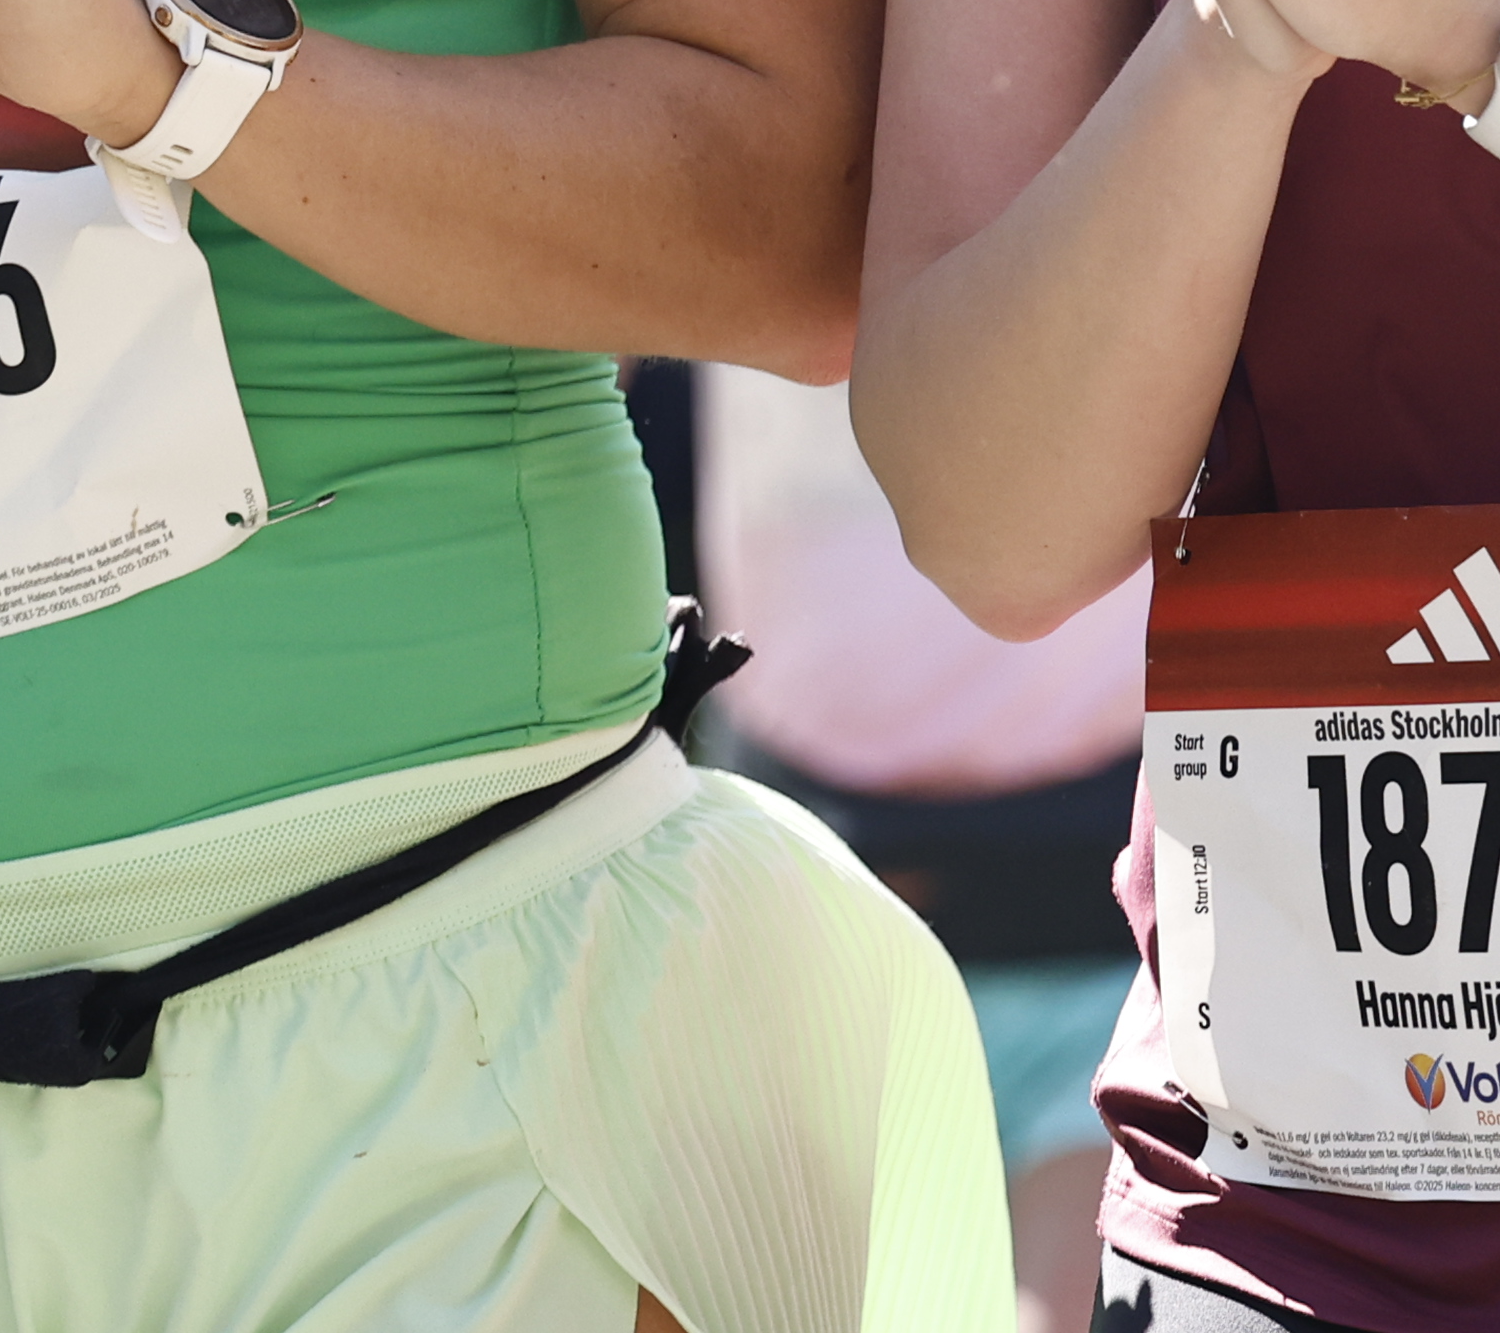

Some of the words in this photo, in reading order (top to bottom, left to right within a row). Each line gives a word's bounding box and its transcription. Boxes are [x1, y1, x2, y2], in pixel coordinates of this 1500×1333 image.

[1174, 733, 1204, 751] Start
[1315, 712, 1385, 742] adidas
[1174, 762, 1207, 781] group
[1220, 735, 1239, 779] G
[1195, 878, 1209, 914] Start
[1199, 1002, 1211, 1030] S
[1356, 980, 1457, 1030] Hanna
